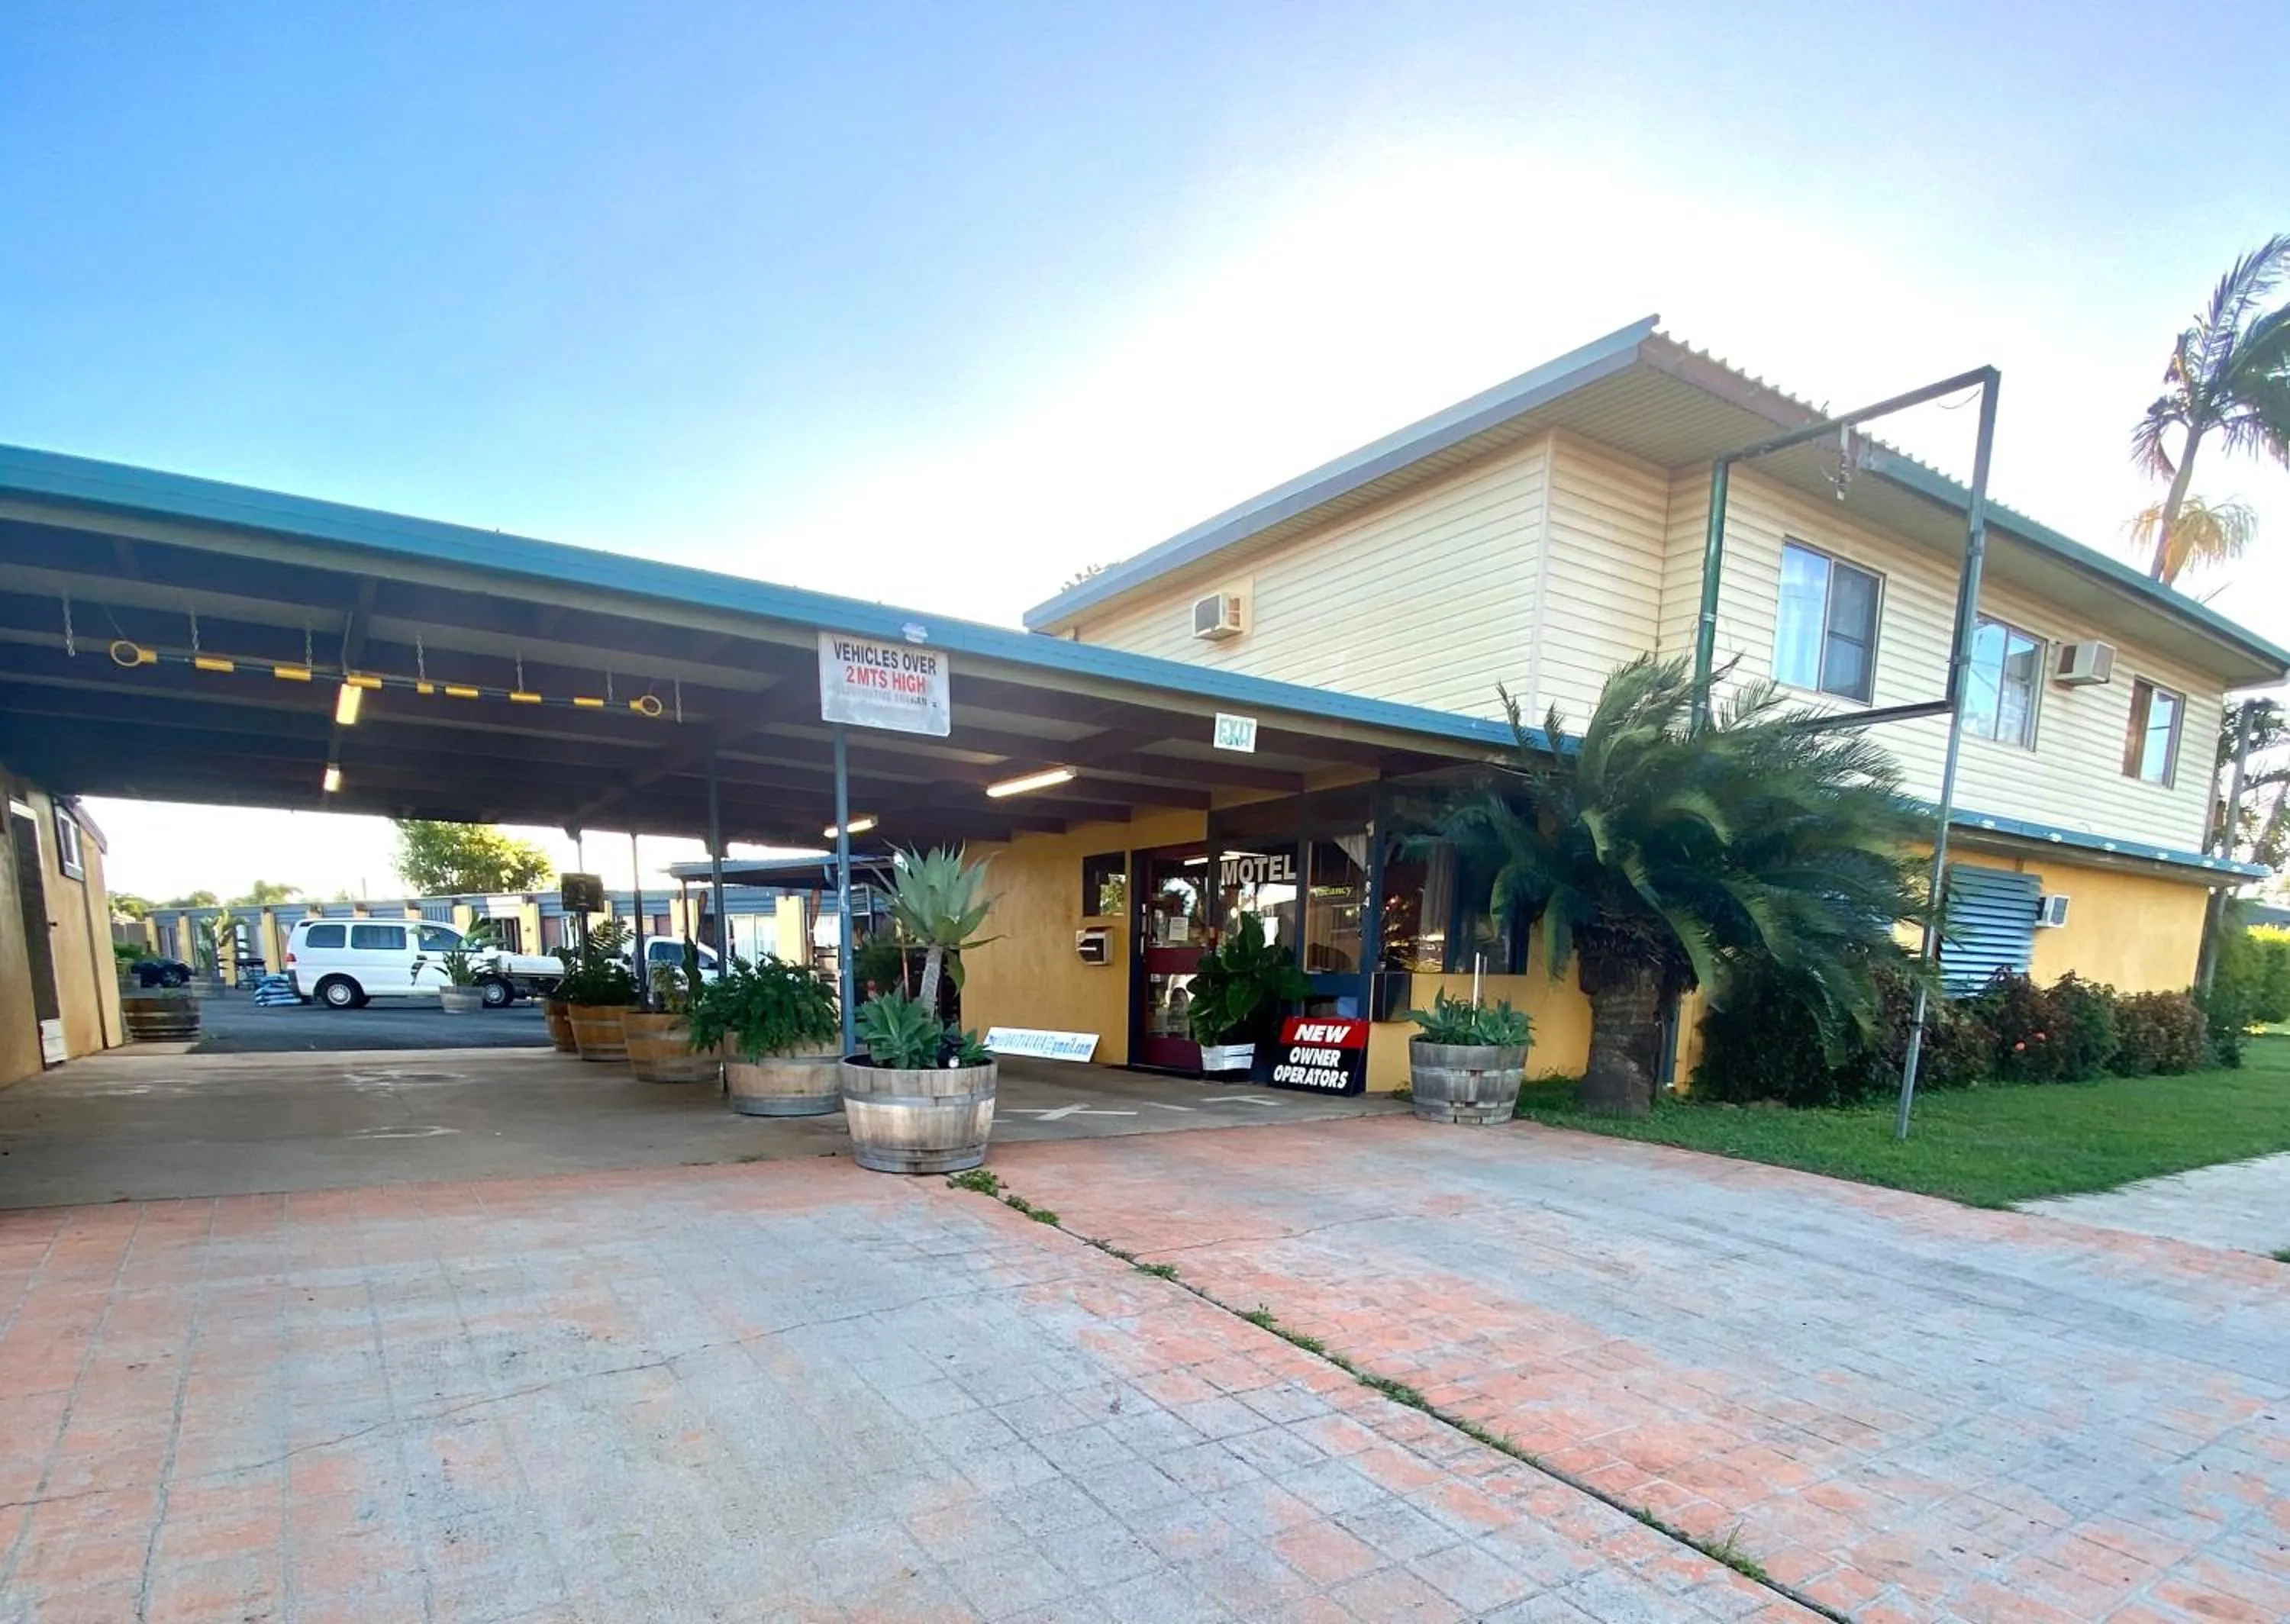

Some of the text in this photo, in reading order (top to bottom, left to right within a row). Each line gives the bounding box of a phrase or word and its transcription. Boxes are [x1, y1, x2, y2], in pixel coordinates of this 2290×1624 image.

[833, 640, 937, 675] VEHICLES OVER
[846, 665, 926, 694] 2 MTS HIGH
[1221, 854, 1297, 885] MOTEL
[1293, 1023, 1351, 1043] NEW
[1289, 1046, 1341, 1068] OWNER
[1273, 1065, 1349, 1089] OPERATORS
